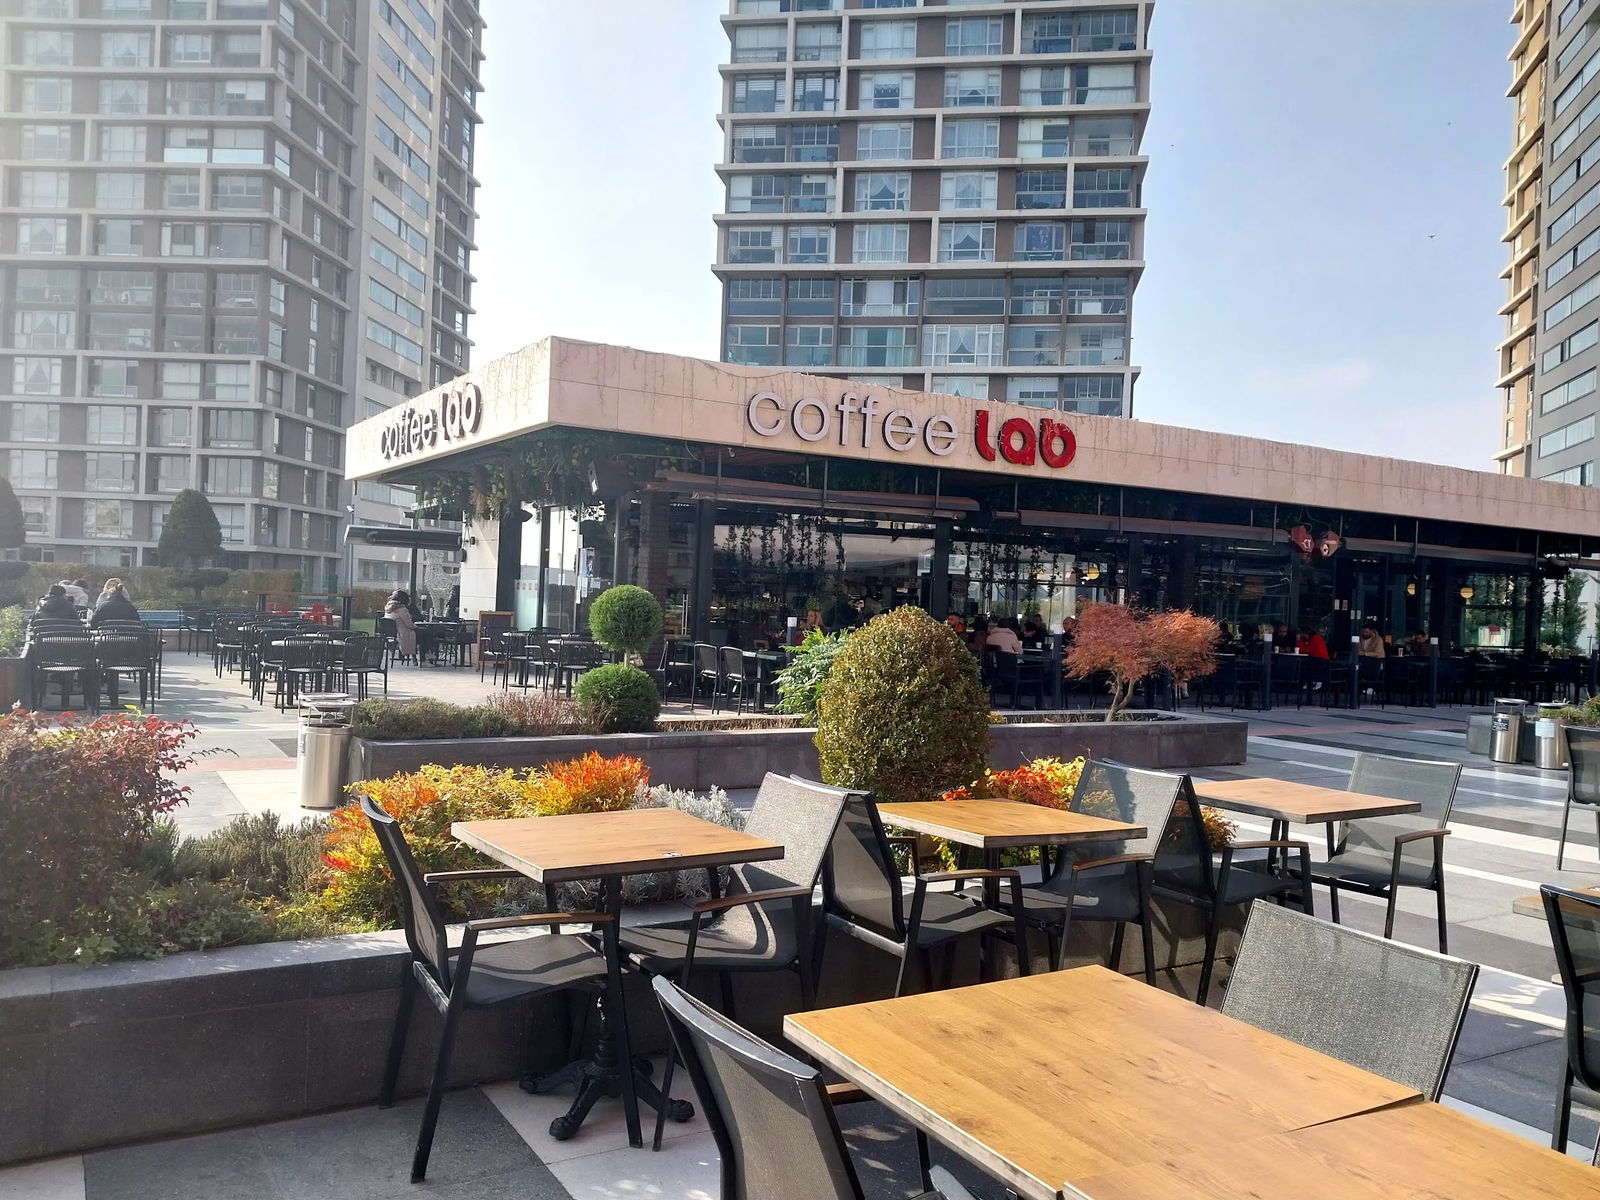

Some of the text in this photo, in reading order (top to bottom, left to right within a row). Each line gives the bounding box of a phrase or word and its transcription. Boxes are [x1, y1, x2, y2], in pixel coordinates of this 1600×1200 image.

[381, 382, 482, 460] coffee lab
[747, 391, 1077, 469] coffee lab
